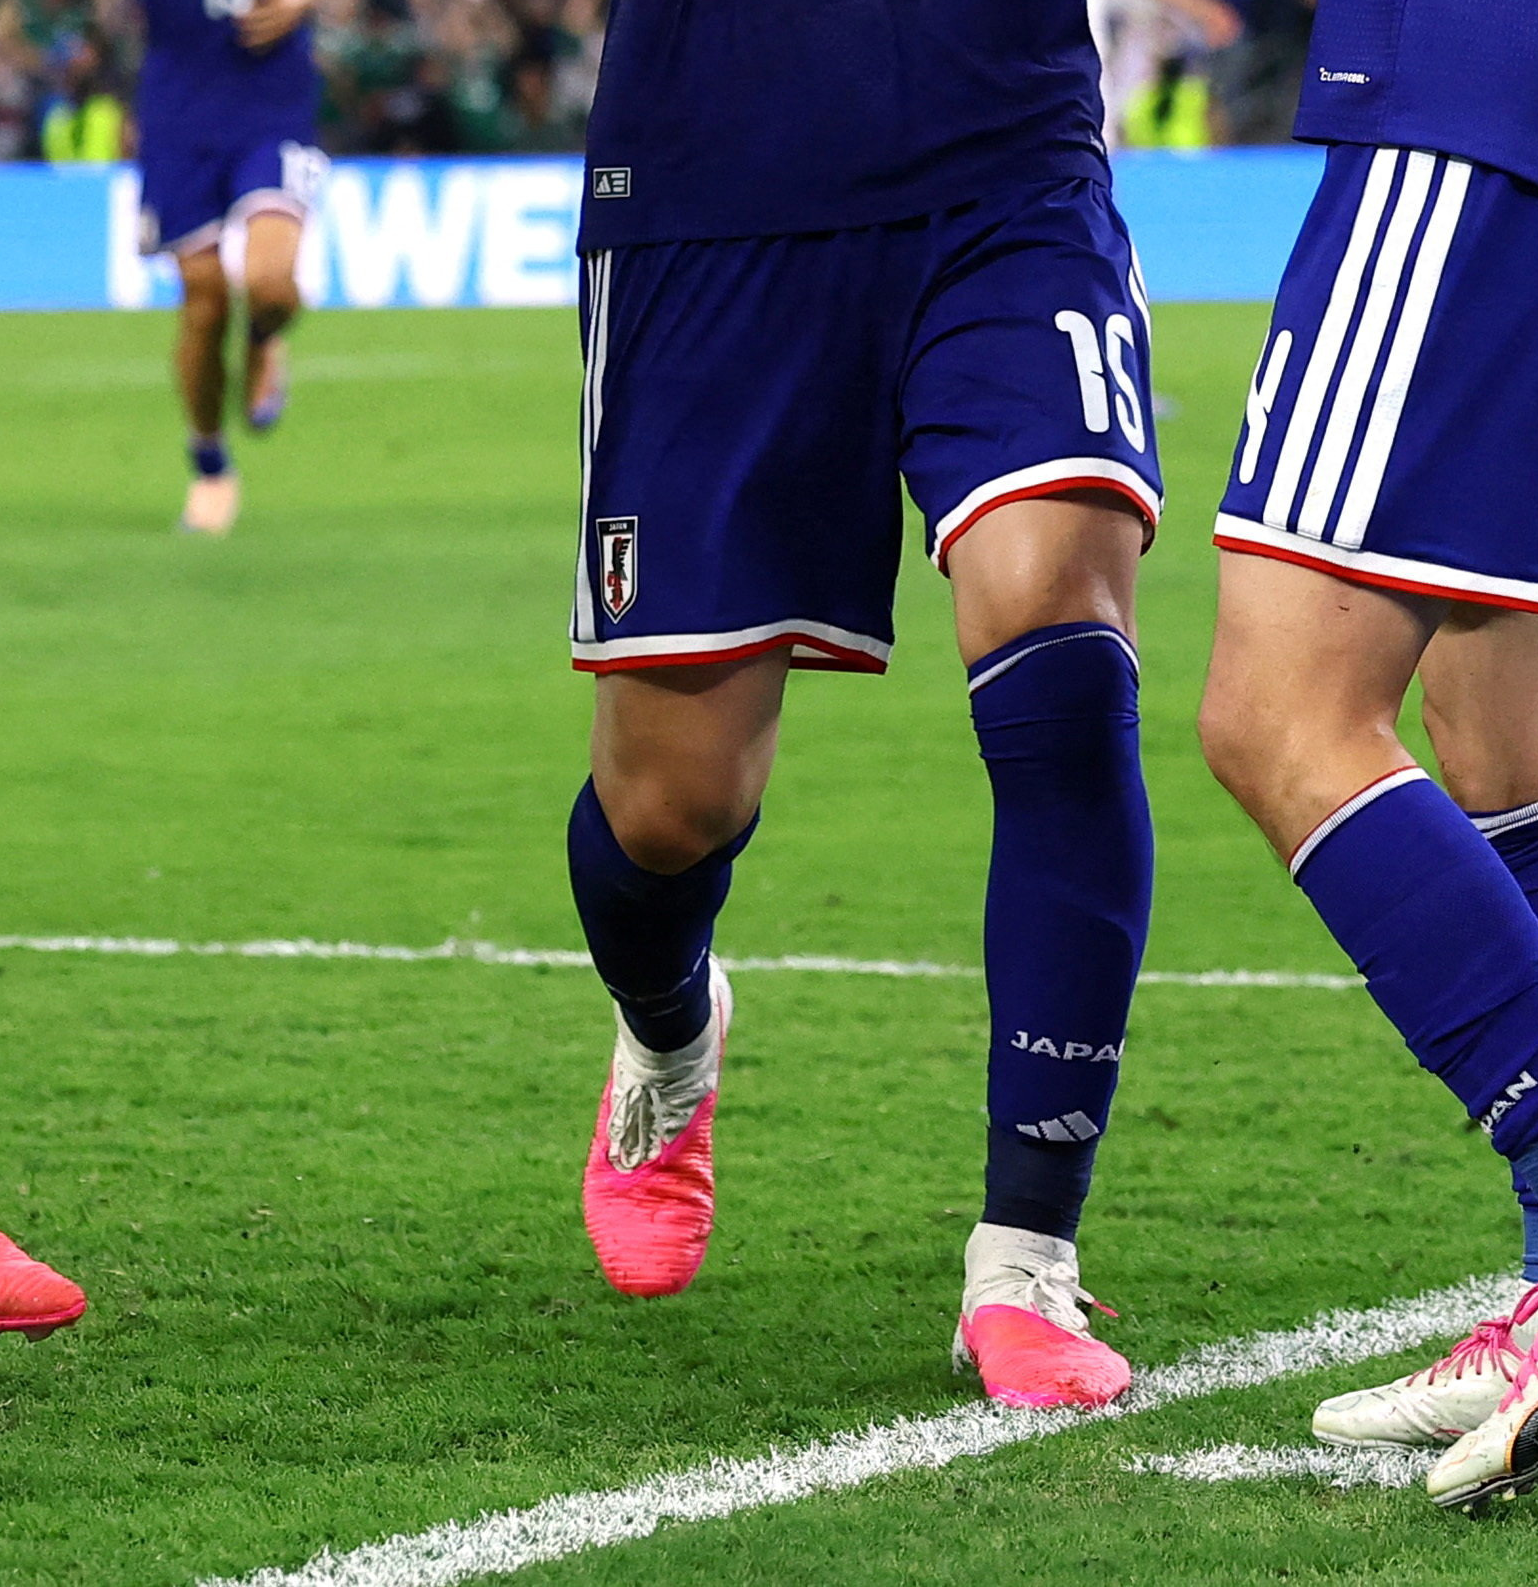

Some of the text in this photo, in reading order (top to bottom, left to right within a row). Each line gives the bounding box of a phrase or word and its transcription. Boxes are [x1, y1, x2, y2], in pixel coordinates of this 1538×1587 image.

[1054, 309, 1146, 455] 15
[1238, 328, 1294, 485] 4
[1480, 1070, 1538, 1135] PAN
